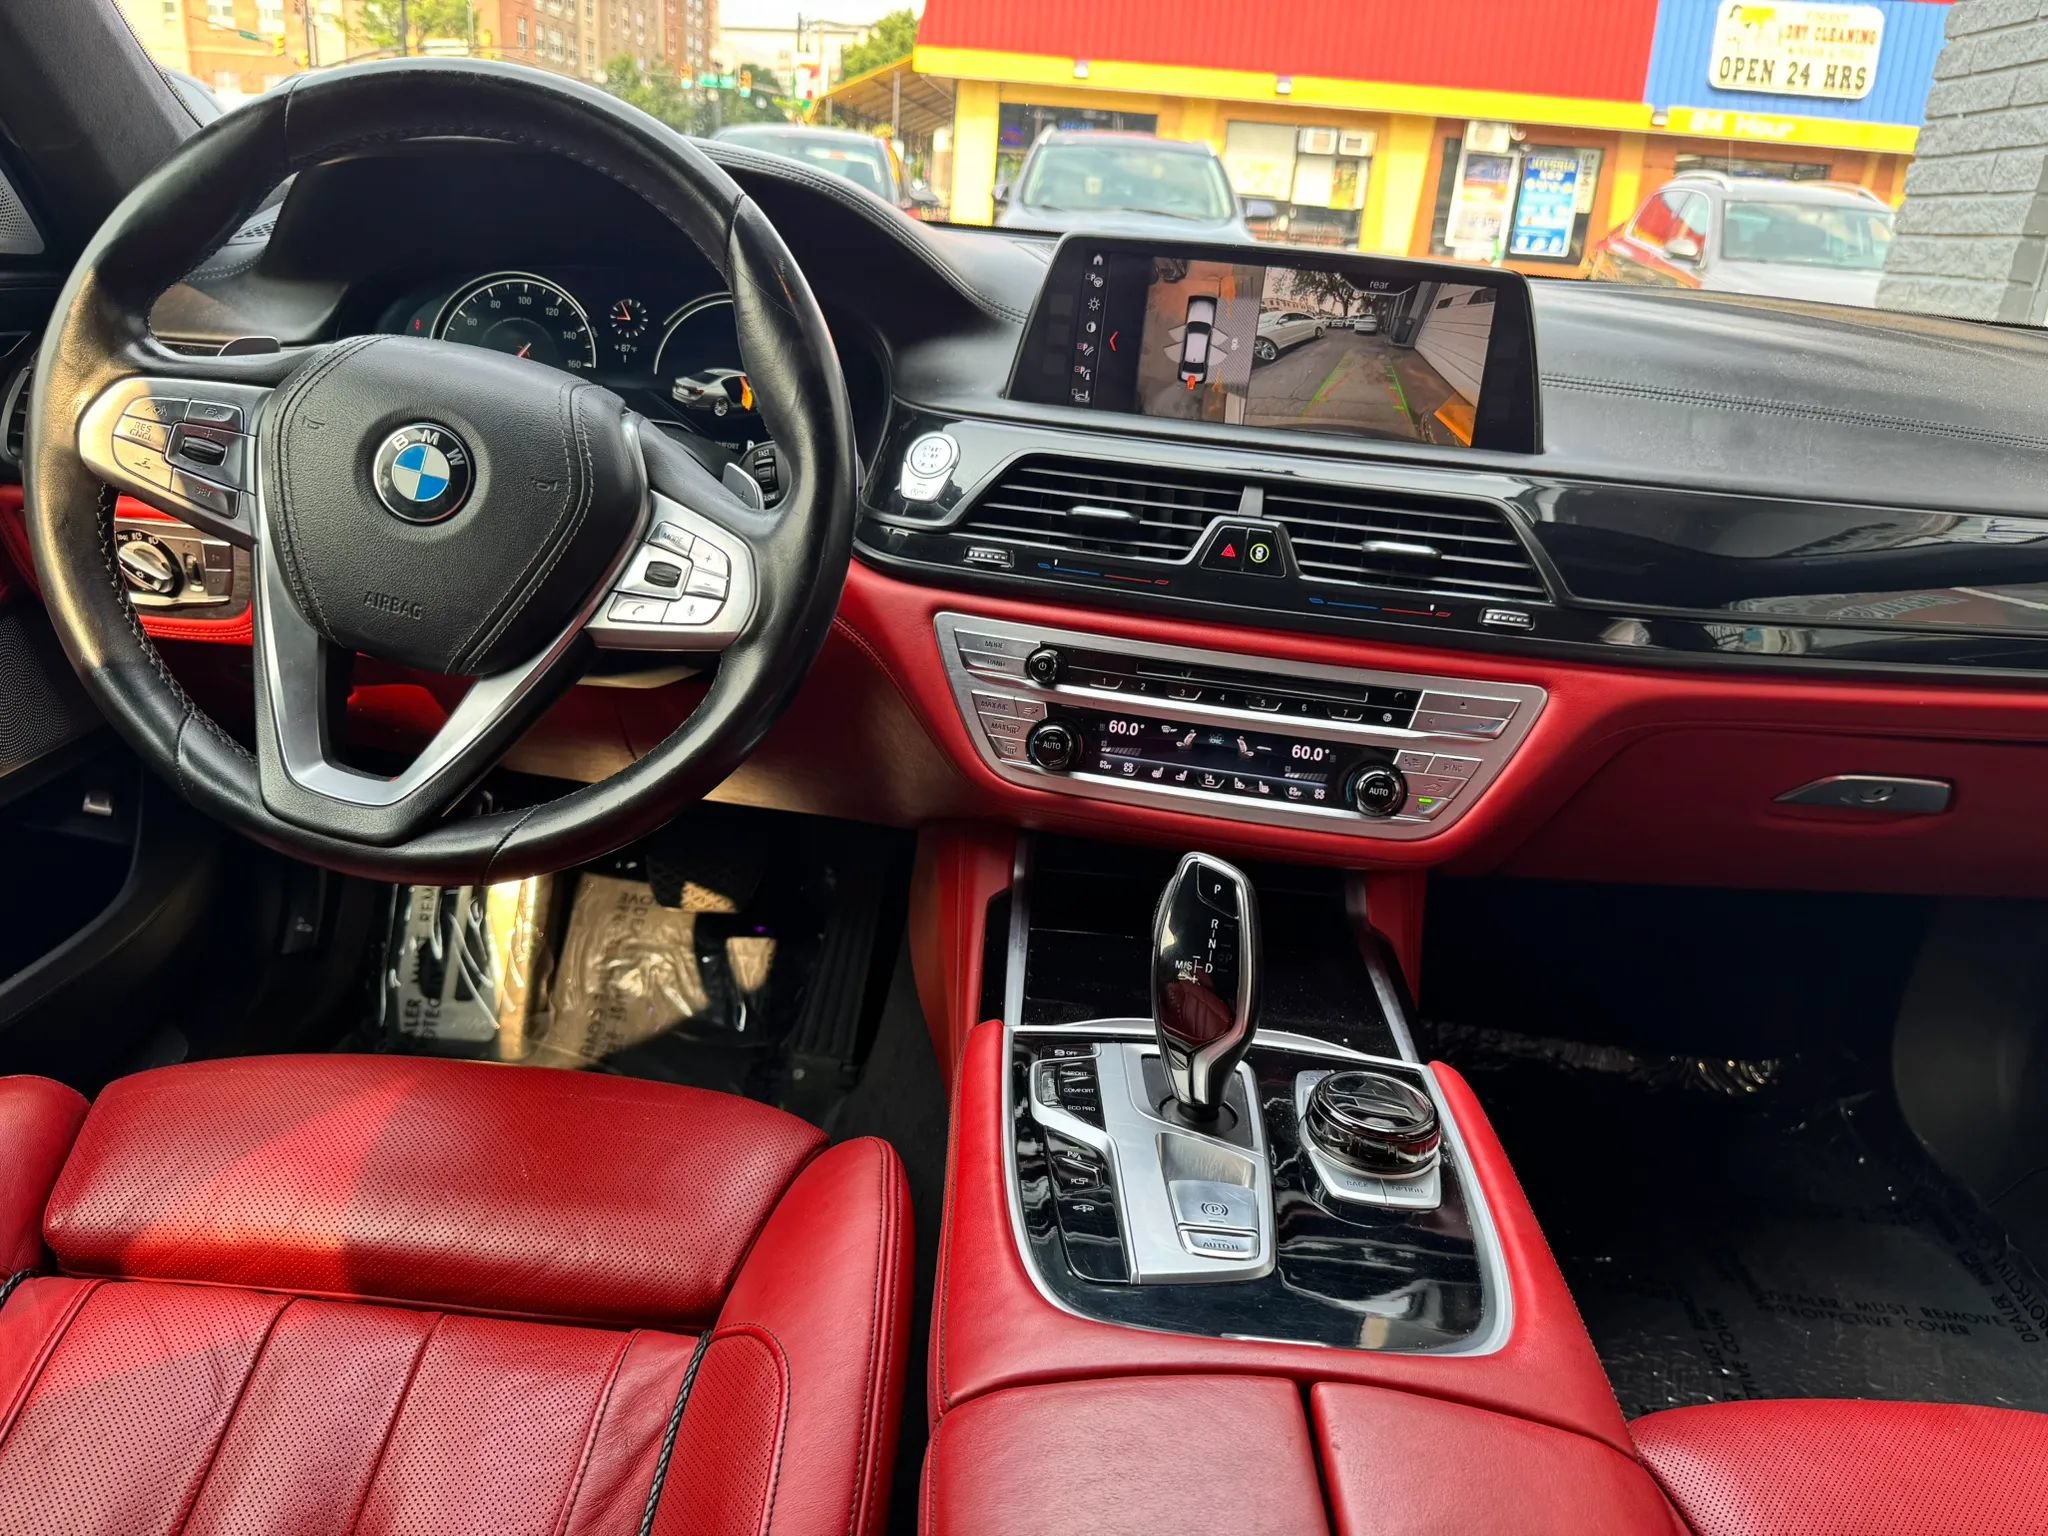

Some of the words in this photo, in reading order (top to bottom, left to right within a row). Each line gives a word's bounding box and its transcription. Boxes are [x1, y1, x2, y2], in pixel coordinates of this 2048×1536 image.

[1787, 25, 1808, 40] DRY
[1815, 28, 1877, 45] CLEANING
[1719, 56, 1775, 84] OPEN
[1786, 61, 1811, 87] 24
[1824, 64, 1867, 91] HRS
[1369, 280, 1390, 289] rear
[490, 300, 501, 309] 80
[518, 296, 532, 306] 100
[545, 307, 559, 317] 120
[467, 318, 478, 327] 60
[563, 331, 577, 341] 140
[568, 359, 582, 369] 160
[392, 429, 465, 466] BMW
[364, 591, 423, 620] AIRBAG
[1140, 682, 1146, 691] 2
[1180, 689, 1185, 697] 3
[1343, 709, 1348, 717] 7
[1042, 741, 1061, 750] AUTO
[1368, 787, 1389, 796] AUTO
[1214, 884, 1222, 894] P
[1211, 919, 1219, 929] R
[1208, 939, 1216, 949] N
[1175, 960, 1193, 971] M/S
[1205, 963, 1213, 974] D
[1346, 1180, 1368, 1188] BACK
[1203, 1241, 1230, 1249] AUTO
[1855, 1300, 1910, 1317] MUST
[1920, 1305, 2010, 1328] REMOVE
[1991, 1294, 2041, 1344] DEALER
[1903, 1317, 1972, 1337] COVER
